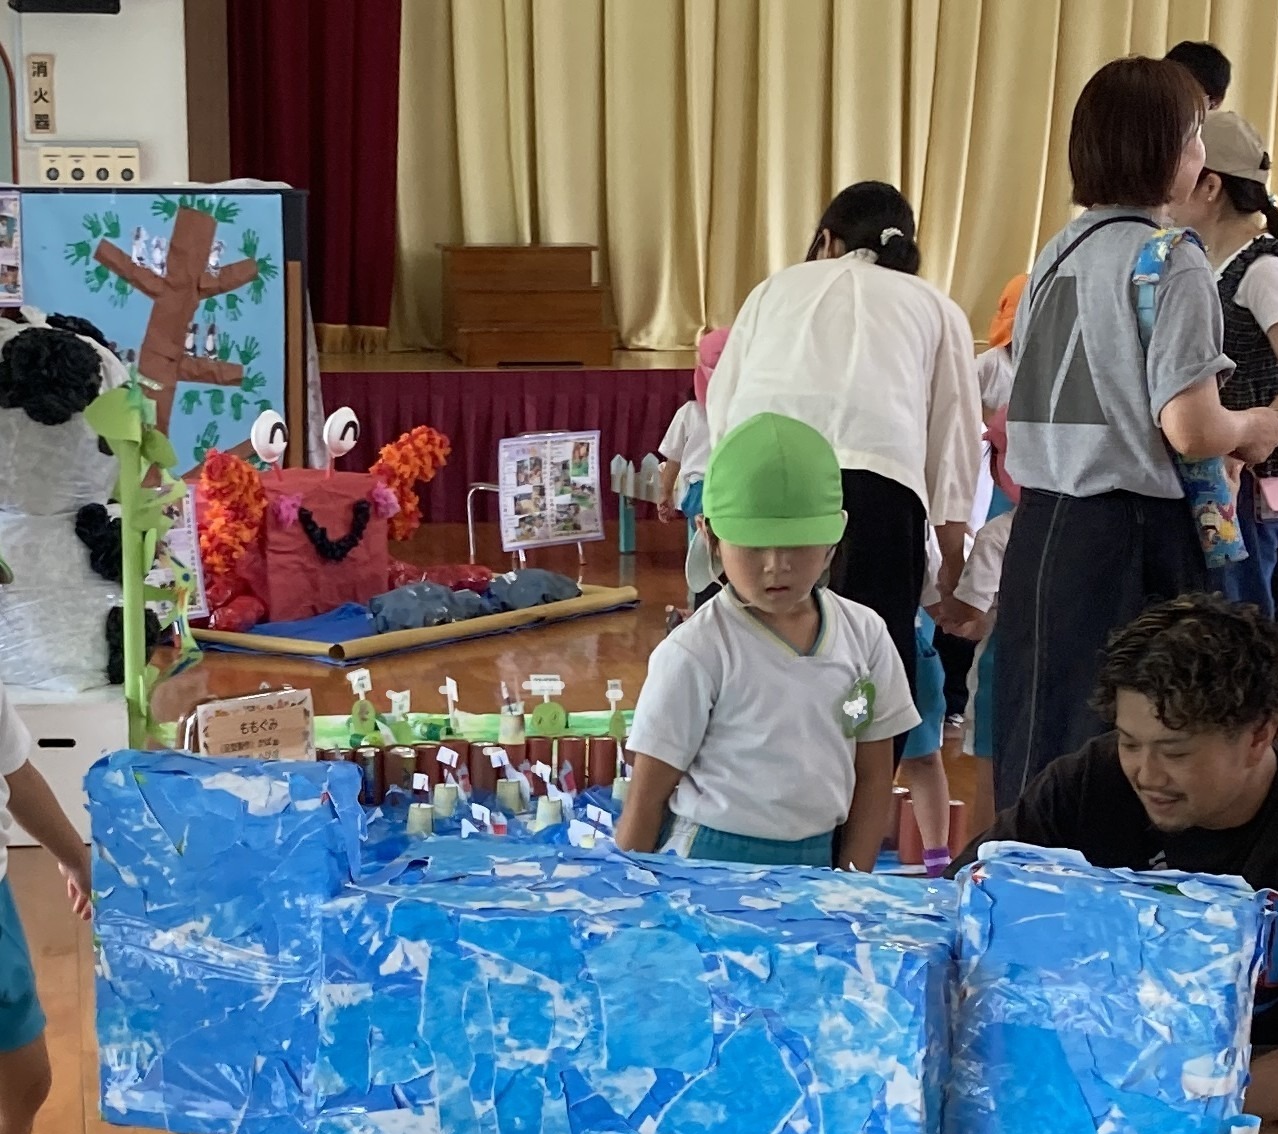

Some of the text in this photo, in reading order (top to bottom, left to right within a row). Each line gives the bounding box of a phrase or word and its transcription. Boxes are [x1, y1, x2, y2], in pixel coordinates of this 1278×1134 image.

[31, 61, 50, 130] 消火器
[240, 718, 278, 734] ももぐみ
